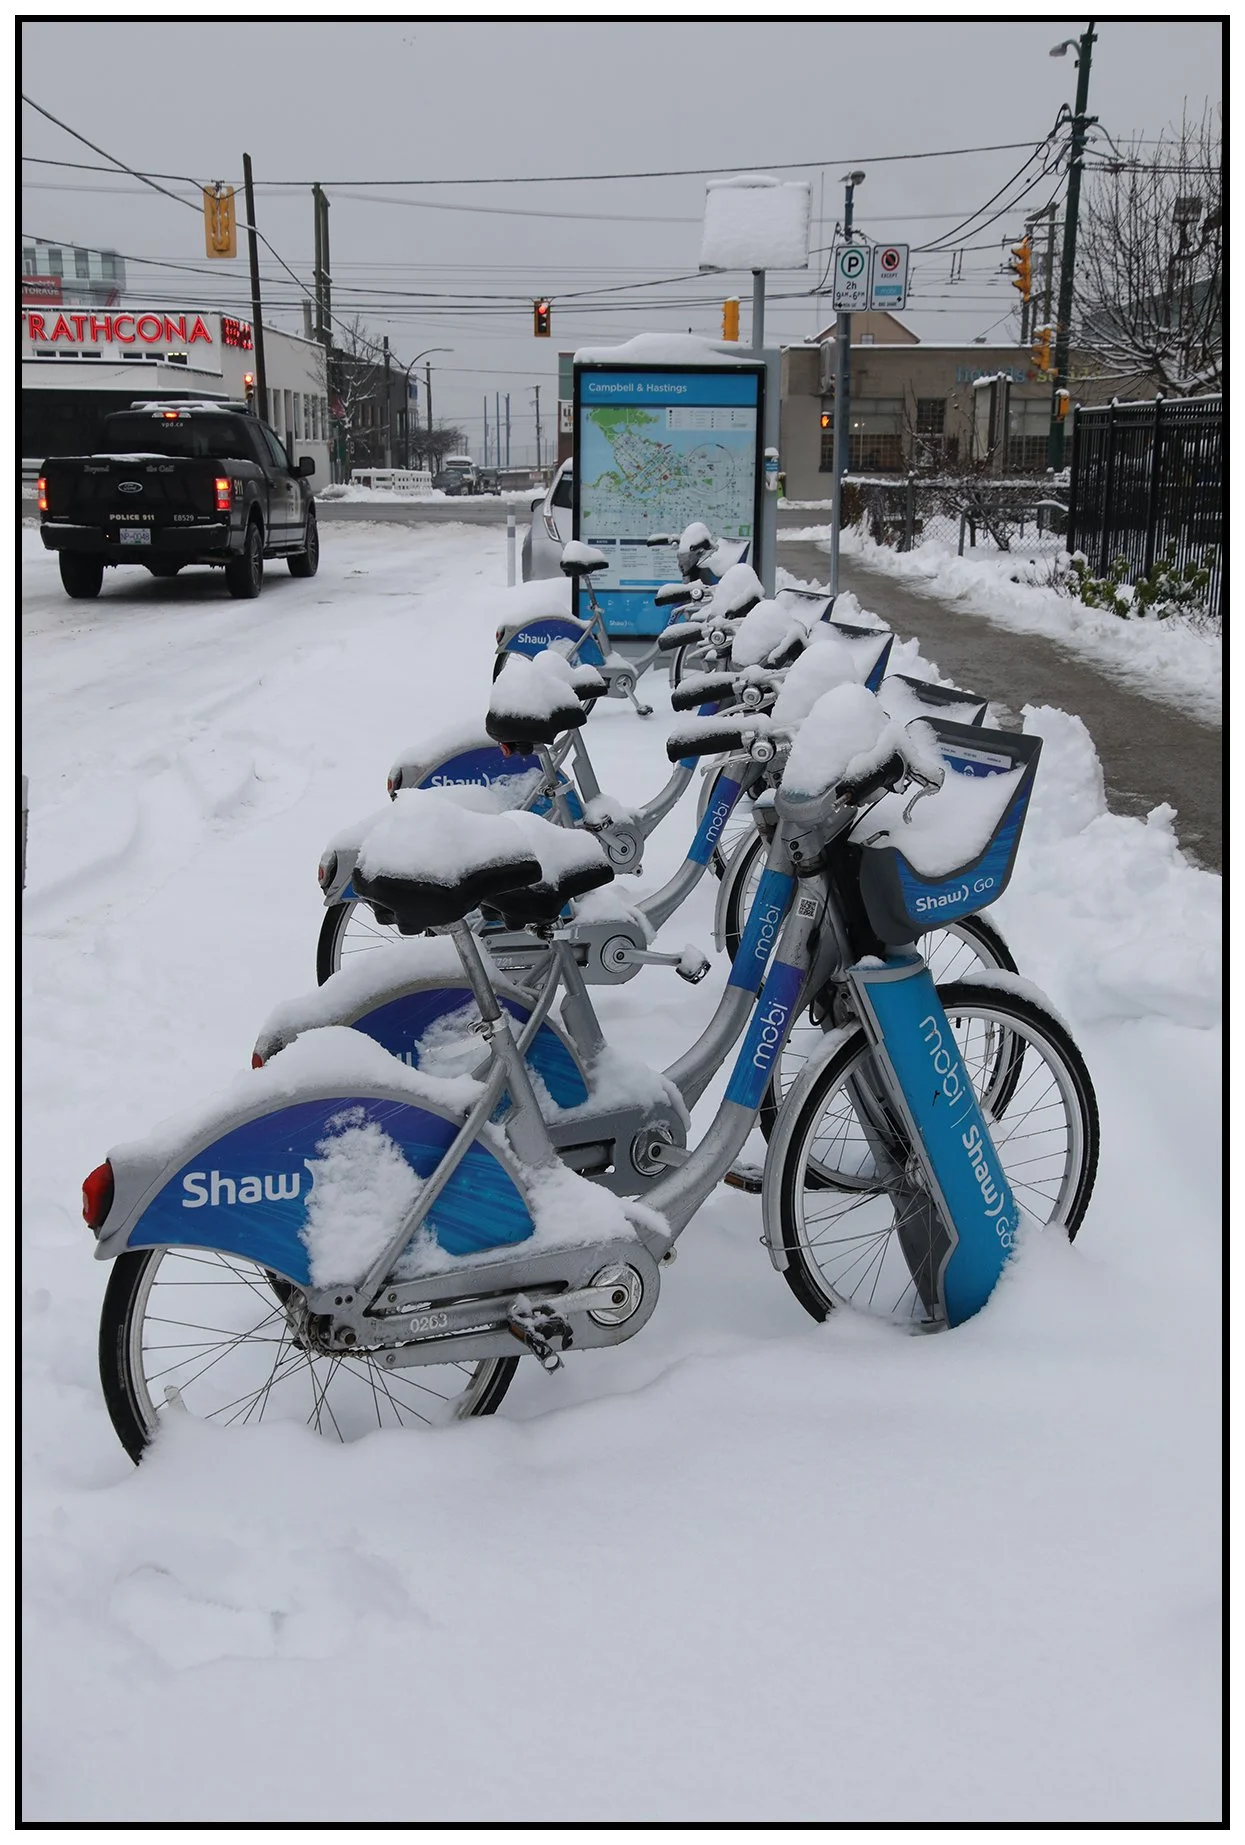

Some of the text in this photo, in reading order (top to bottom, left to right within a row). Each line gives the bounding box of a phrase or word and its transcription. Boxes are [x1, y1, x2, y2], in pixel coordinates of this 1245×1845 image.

[22, 287, 59, 295] TORAGE
[845, 281, 857, 290] 2h
[22, 313, 212, 344] RATHCONA
[588, 383, 688, 394] Campbell & Hastings
[161, 421, 184, 429] vpd.ca
[109, 513, 155, 521] POLICE 911
[705, 800, 730, 843] mobi
[973, 877, 995, 893] Go
[754, 901, 782, 961] mobi
[752, 997, 789, 1070] mobi
[919, 1015, 966, 1107] mobi
[995, 1216, 1015, 1248] Go
[410, 1312, 448, 1333] 0263
